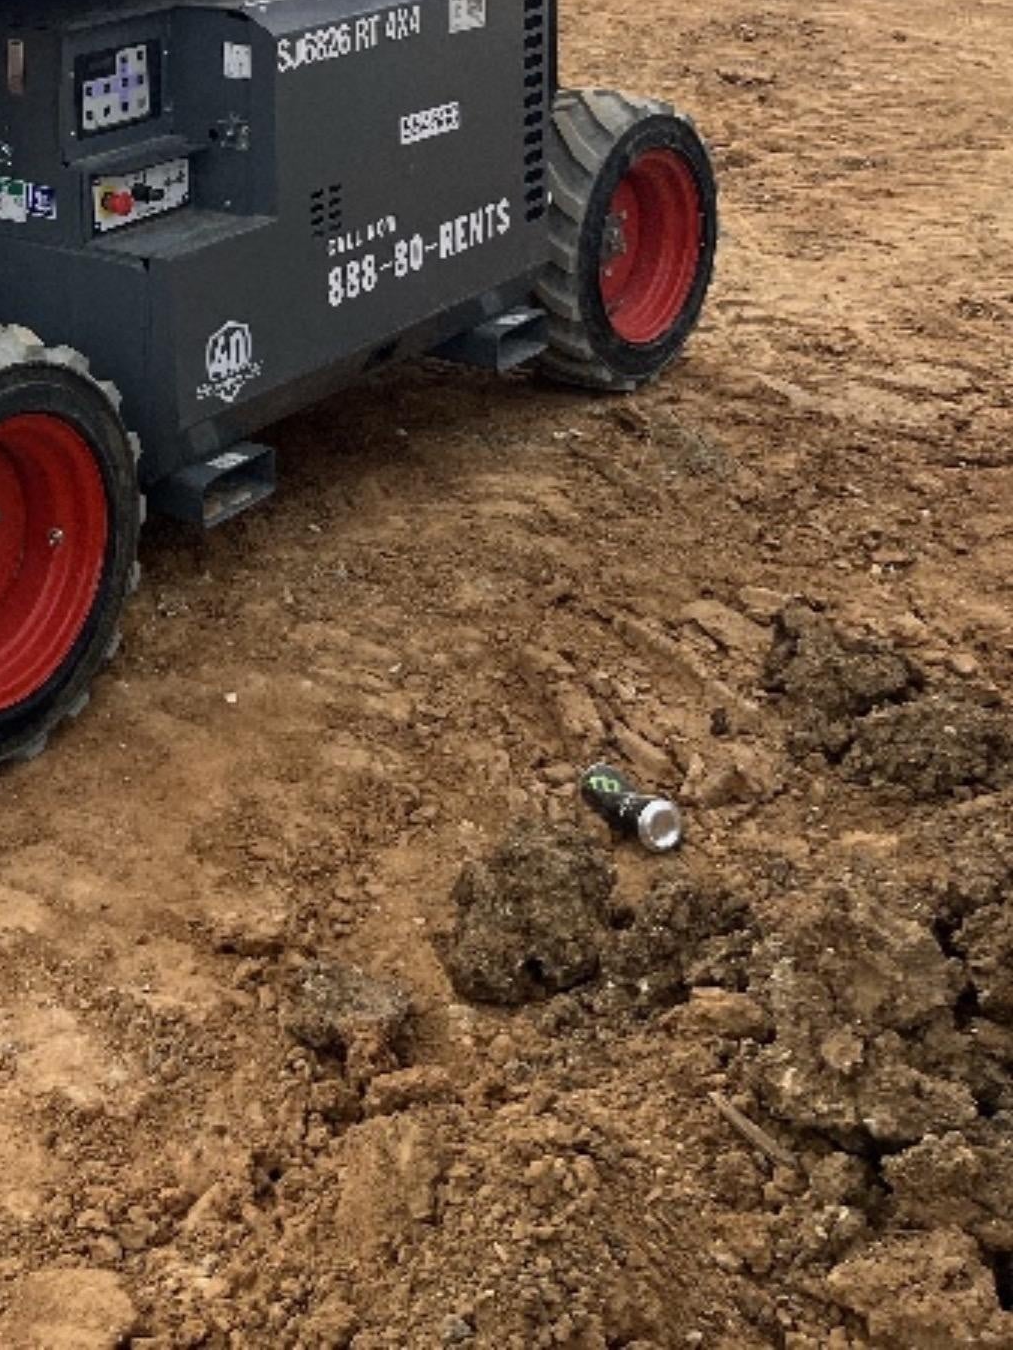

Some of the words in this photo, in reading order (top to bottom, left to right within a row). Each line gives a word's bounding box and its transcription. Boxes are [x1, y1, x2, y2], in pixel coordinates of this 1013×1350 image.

[277, 23, 351, 73] SJ6826
[356, 14, 380, 51] RT
[386, 5, 420, 40] 4X4
[328, 197, 511, 306] 888-80-RENTS
